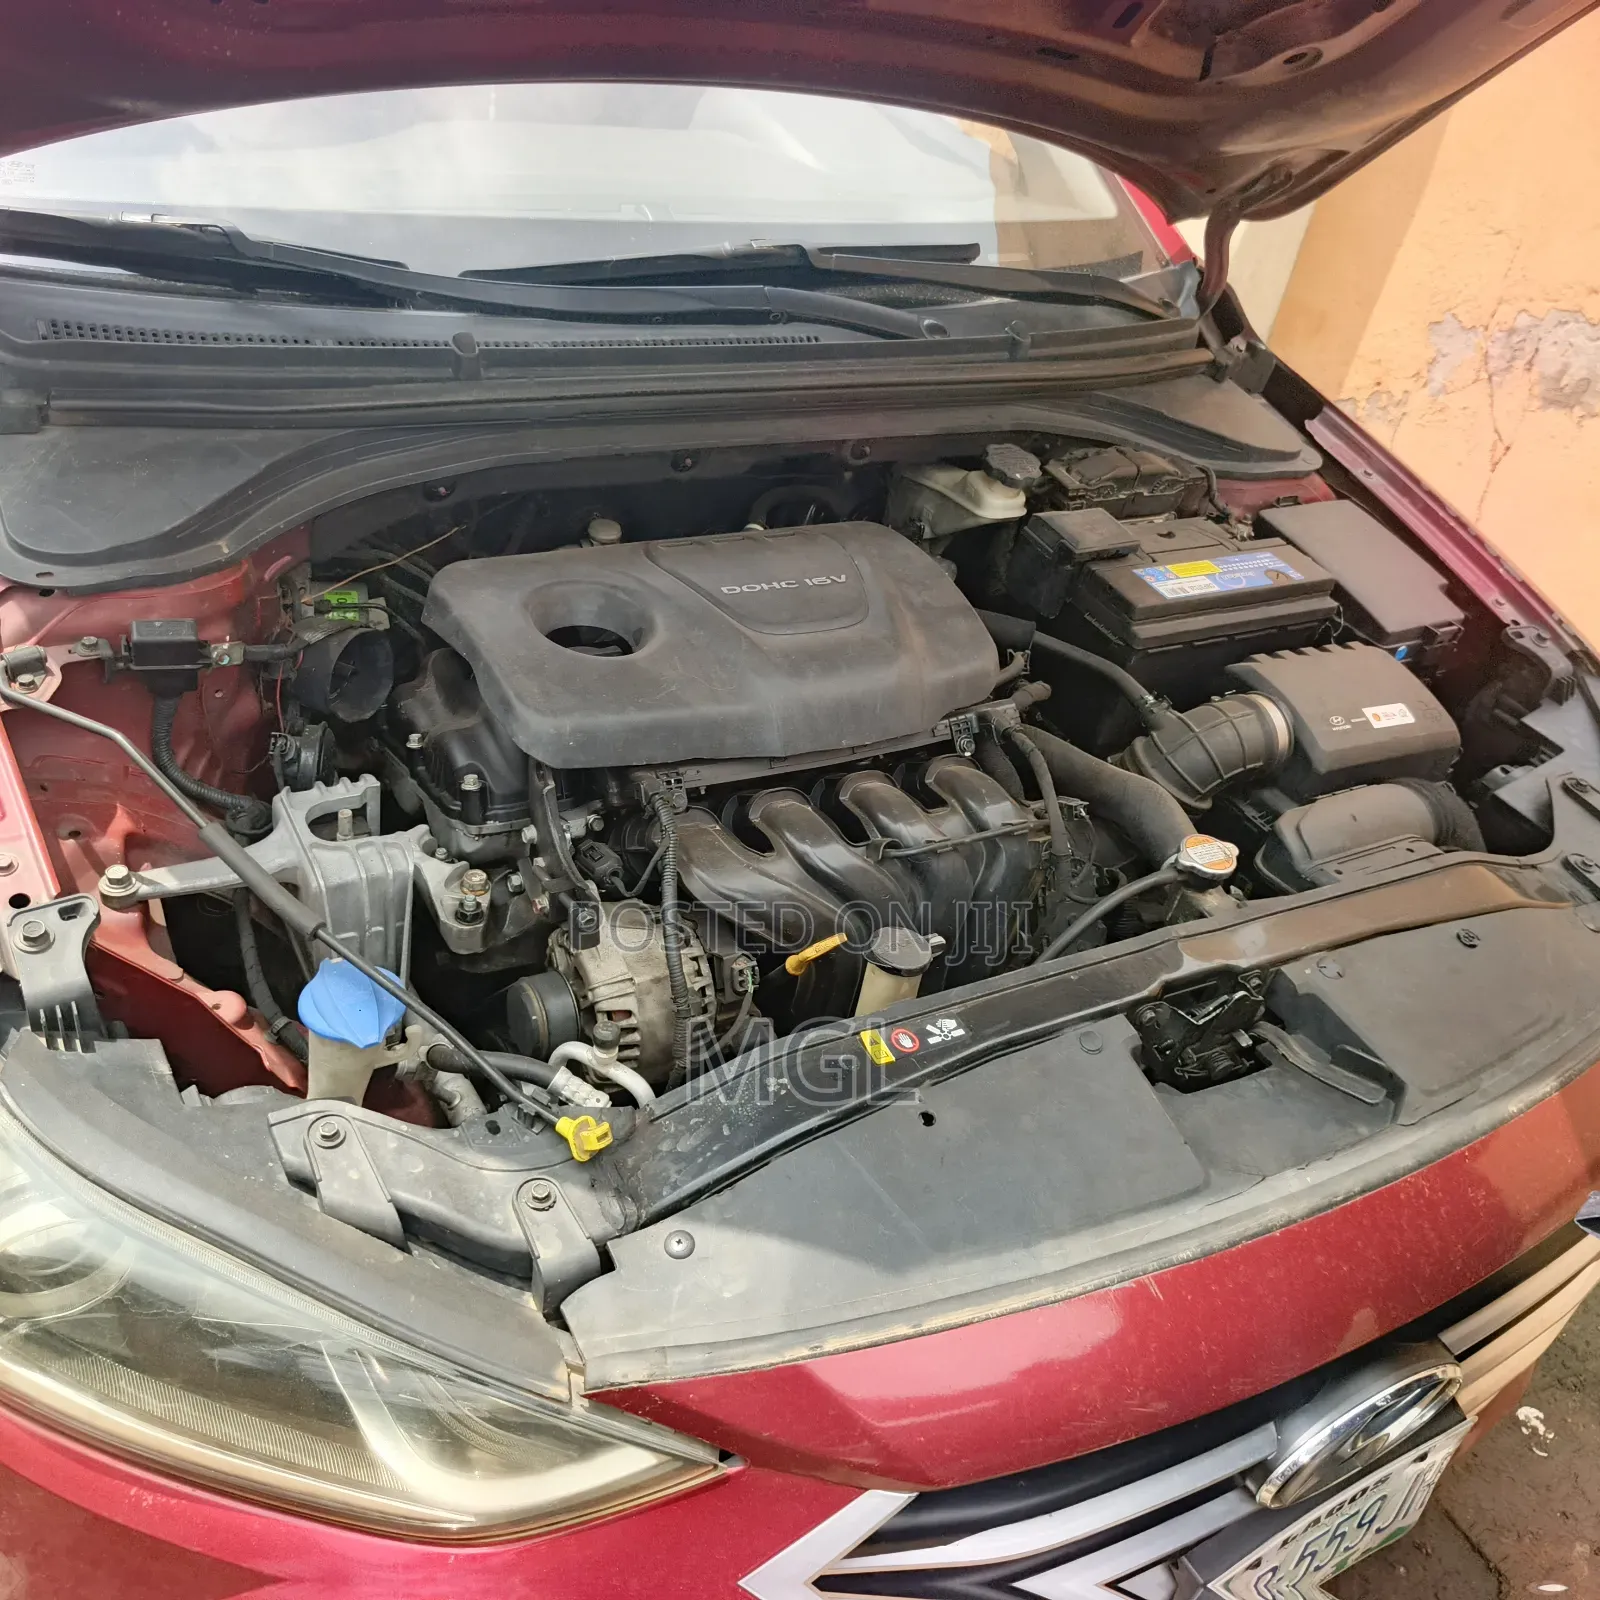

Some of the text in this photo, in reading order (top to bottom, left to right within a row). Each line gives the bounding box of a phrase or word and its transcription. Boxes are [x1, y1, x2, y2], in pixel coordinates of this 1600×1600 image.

[720, 574, 847, 594] DOHC 16V
[1278, 1472, 1393, 1550] LAGOS
